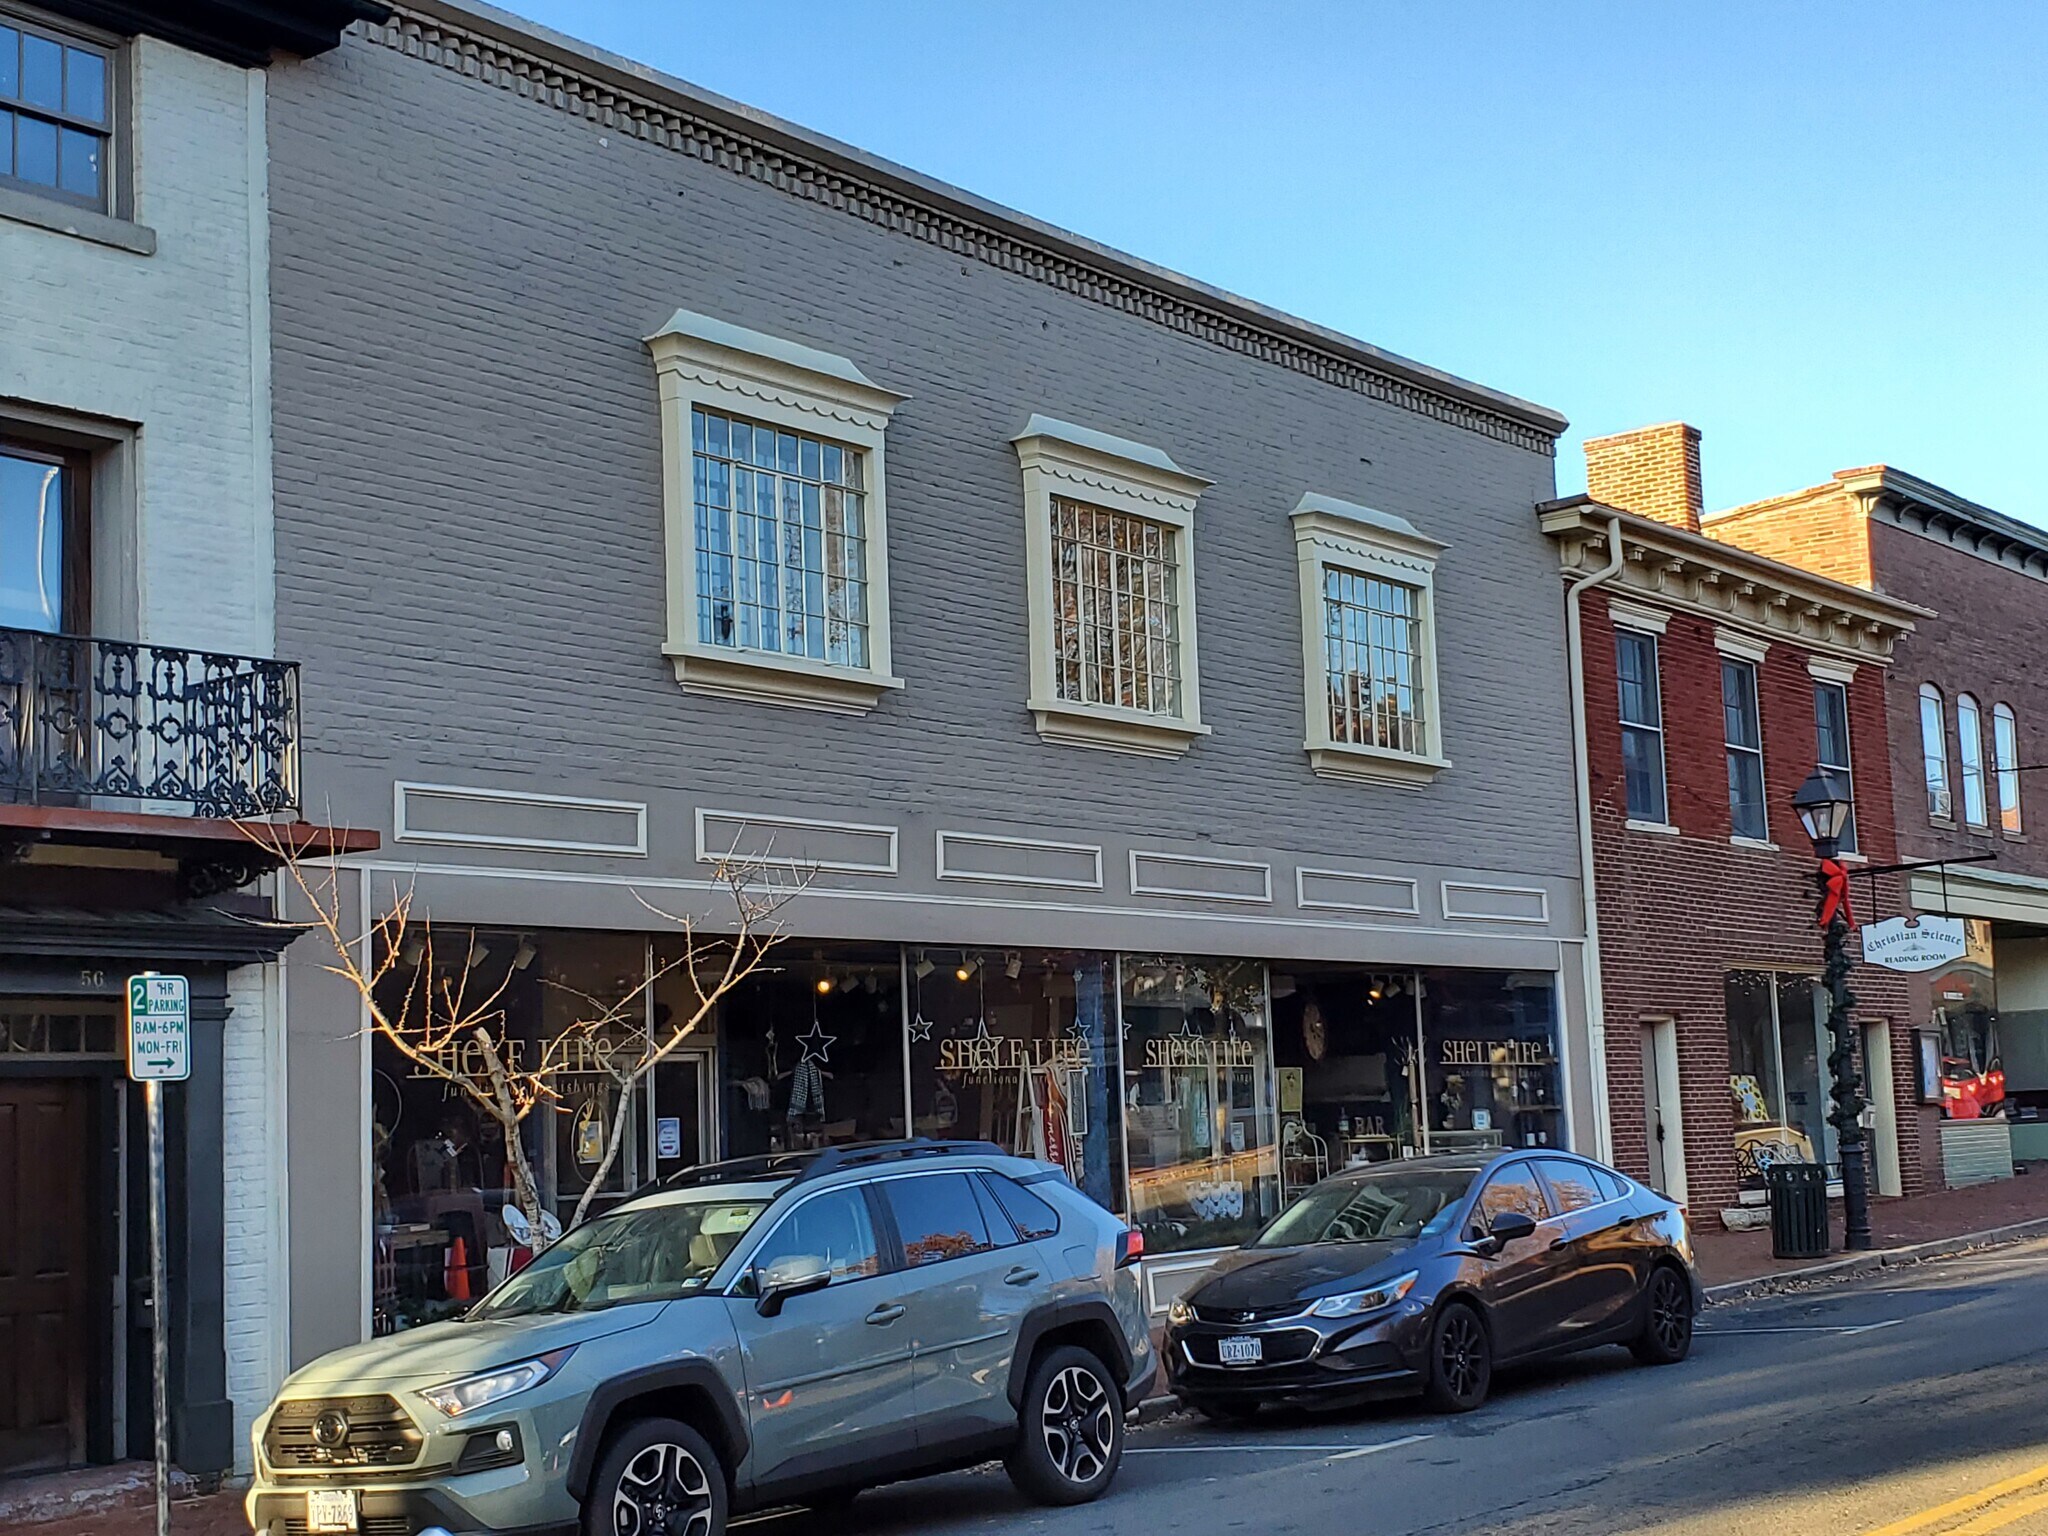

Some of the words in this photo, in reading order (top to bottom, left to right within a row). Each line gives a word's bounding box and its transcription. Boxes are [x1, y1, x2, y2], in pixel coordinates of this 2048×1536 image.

[1867, 930, 1917, 952] Christian
[1921, 929, 1962, 946] Science
[1884, 955, 1919, 963] READING
[1921, 953, 1947, 962] ROOM
[81, 970, 104, 988] 56
[132, 984, 146, 1010] 2
[159, 982, 174, 996] HR
[148, 999, 185, 1012] PARKING
[135, 1021, 184, 1034] 8AM-6PM
[137, 1040, 183, 1054] MON-FRI
[962, 1072, 1021, 1088] functiona
[1354, 1116, 1384, 1136] BAR
